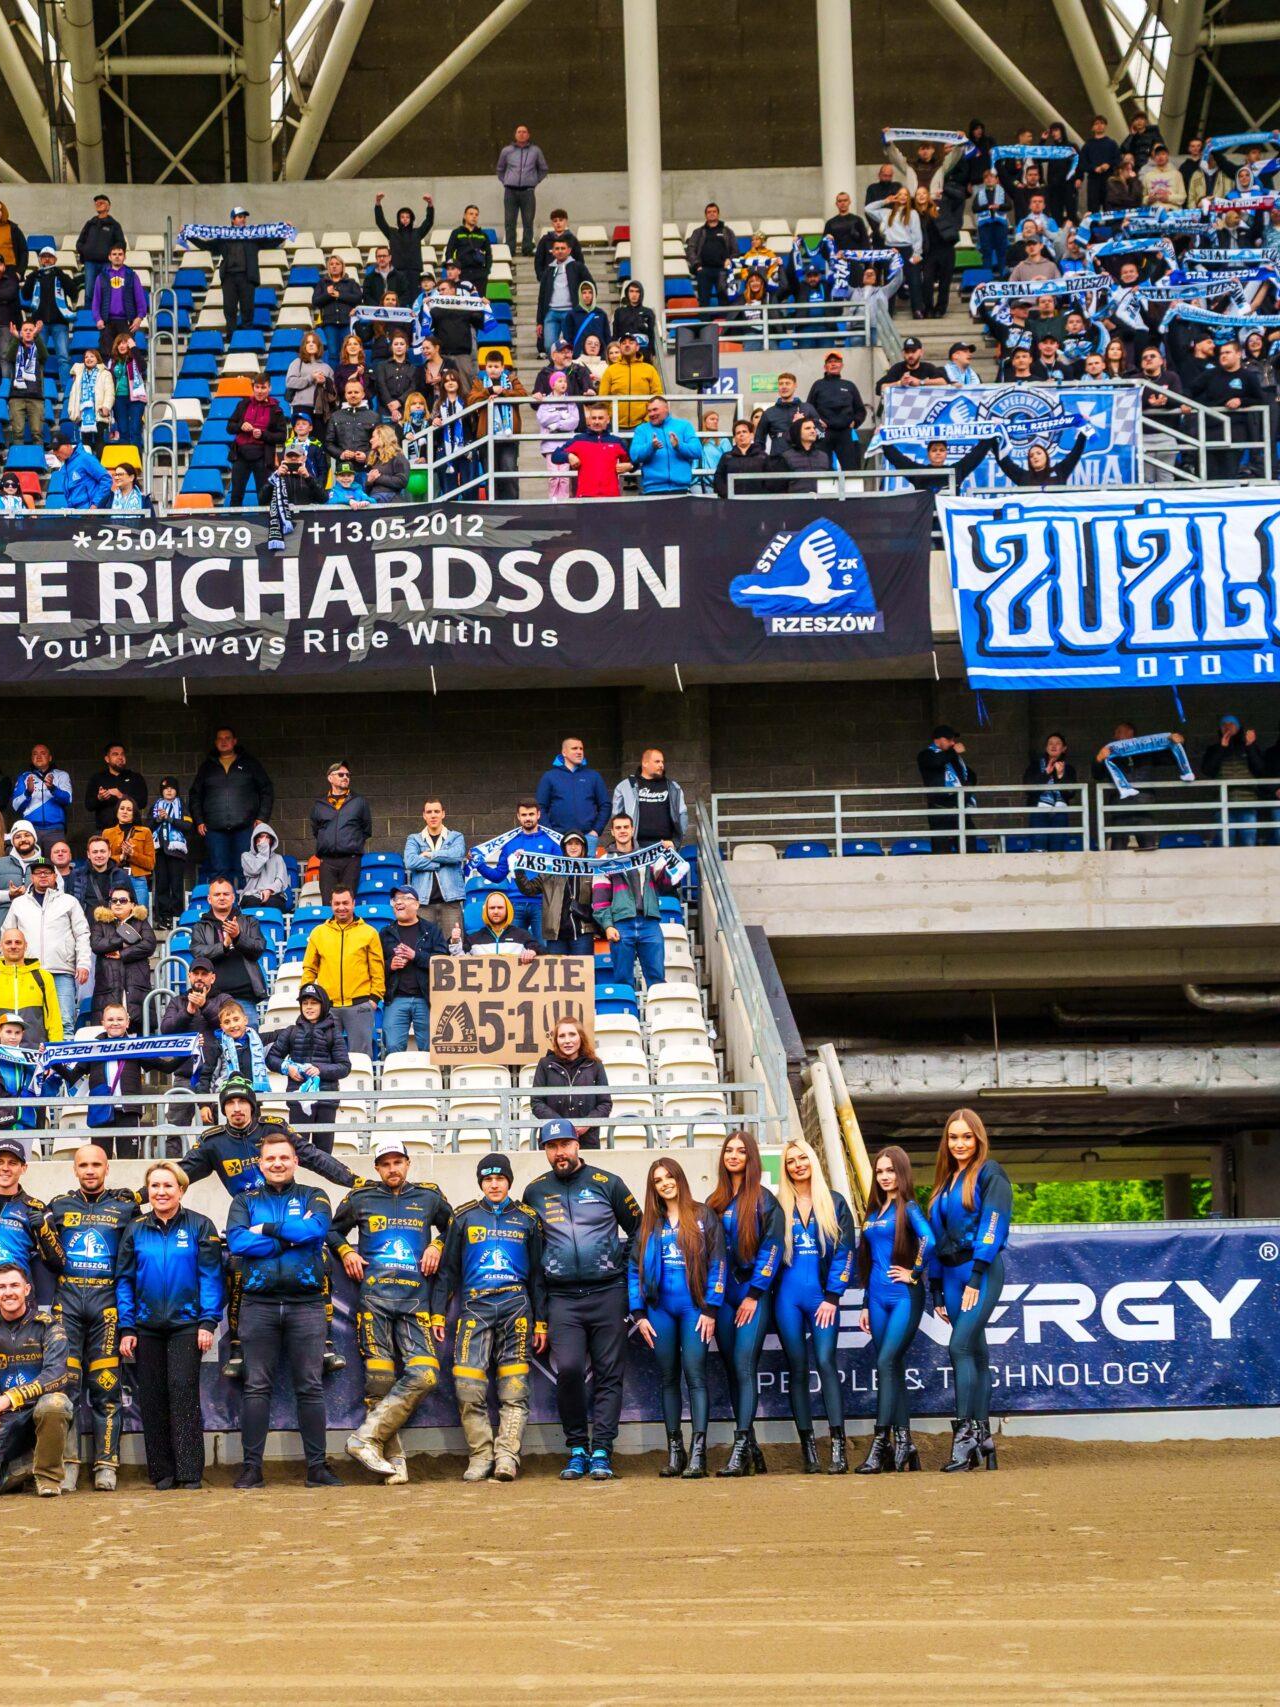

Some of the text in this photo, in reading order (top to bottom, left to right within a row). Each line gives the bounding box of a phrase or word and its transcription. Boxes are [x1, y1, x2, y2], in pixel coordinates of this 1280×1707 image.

[756, 531, 793, 574] STAL
[838, 557, 858, 570] ZK
[99, 545, 681, 625] RICHARDSON
[842, 574, 852, 586] S
[771, 614, 876, 634] RZESZÓW
[147, 632, 286, 661] Always
[304, 625, 389, 654] Ride
[407, 619, 492, 646] With
[513, 622, 558, 648] Us
[1137, 654, 1221, 678] OTO
[516, 853, 546, 871] ZKS
[552, 859, 595, 875] STAL
[99, 1041, 125, 1054] STAL
[127, 1039, 191, 1052] SPEEDWAY
[81, 1212, 119, 1224] rzeszów
[387, 1217, 424, 1228] rzeszów
[69, 1232, 83, 1248] STAL
[487, 1228, 525, 1239] rzeszów
[72, 1261, 109, 1270] RZESZÓW
